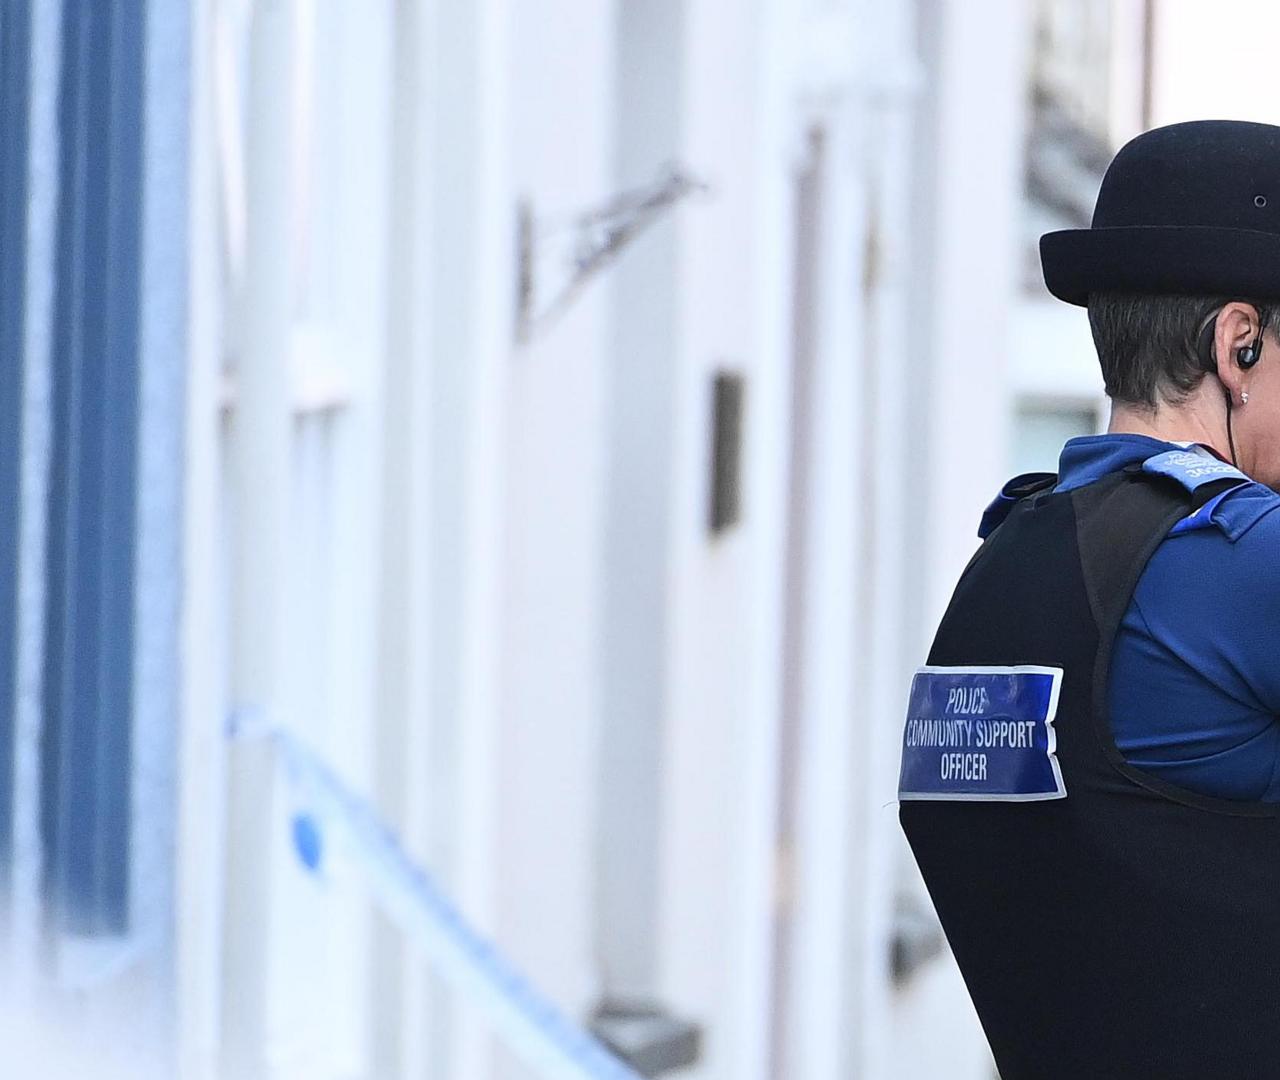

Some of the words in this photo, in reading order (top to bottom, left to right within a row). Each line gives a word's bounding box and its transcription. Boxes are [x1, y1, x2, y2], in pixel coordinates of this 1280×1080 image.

[945, 687, 987, 715] POLICE
[907, 720, 973, 747] COMMUNITY
[976, 720, 1036, 748] SUPPORT
[940, 753, 987, 780] OFFICER
